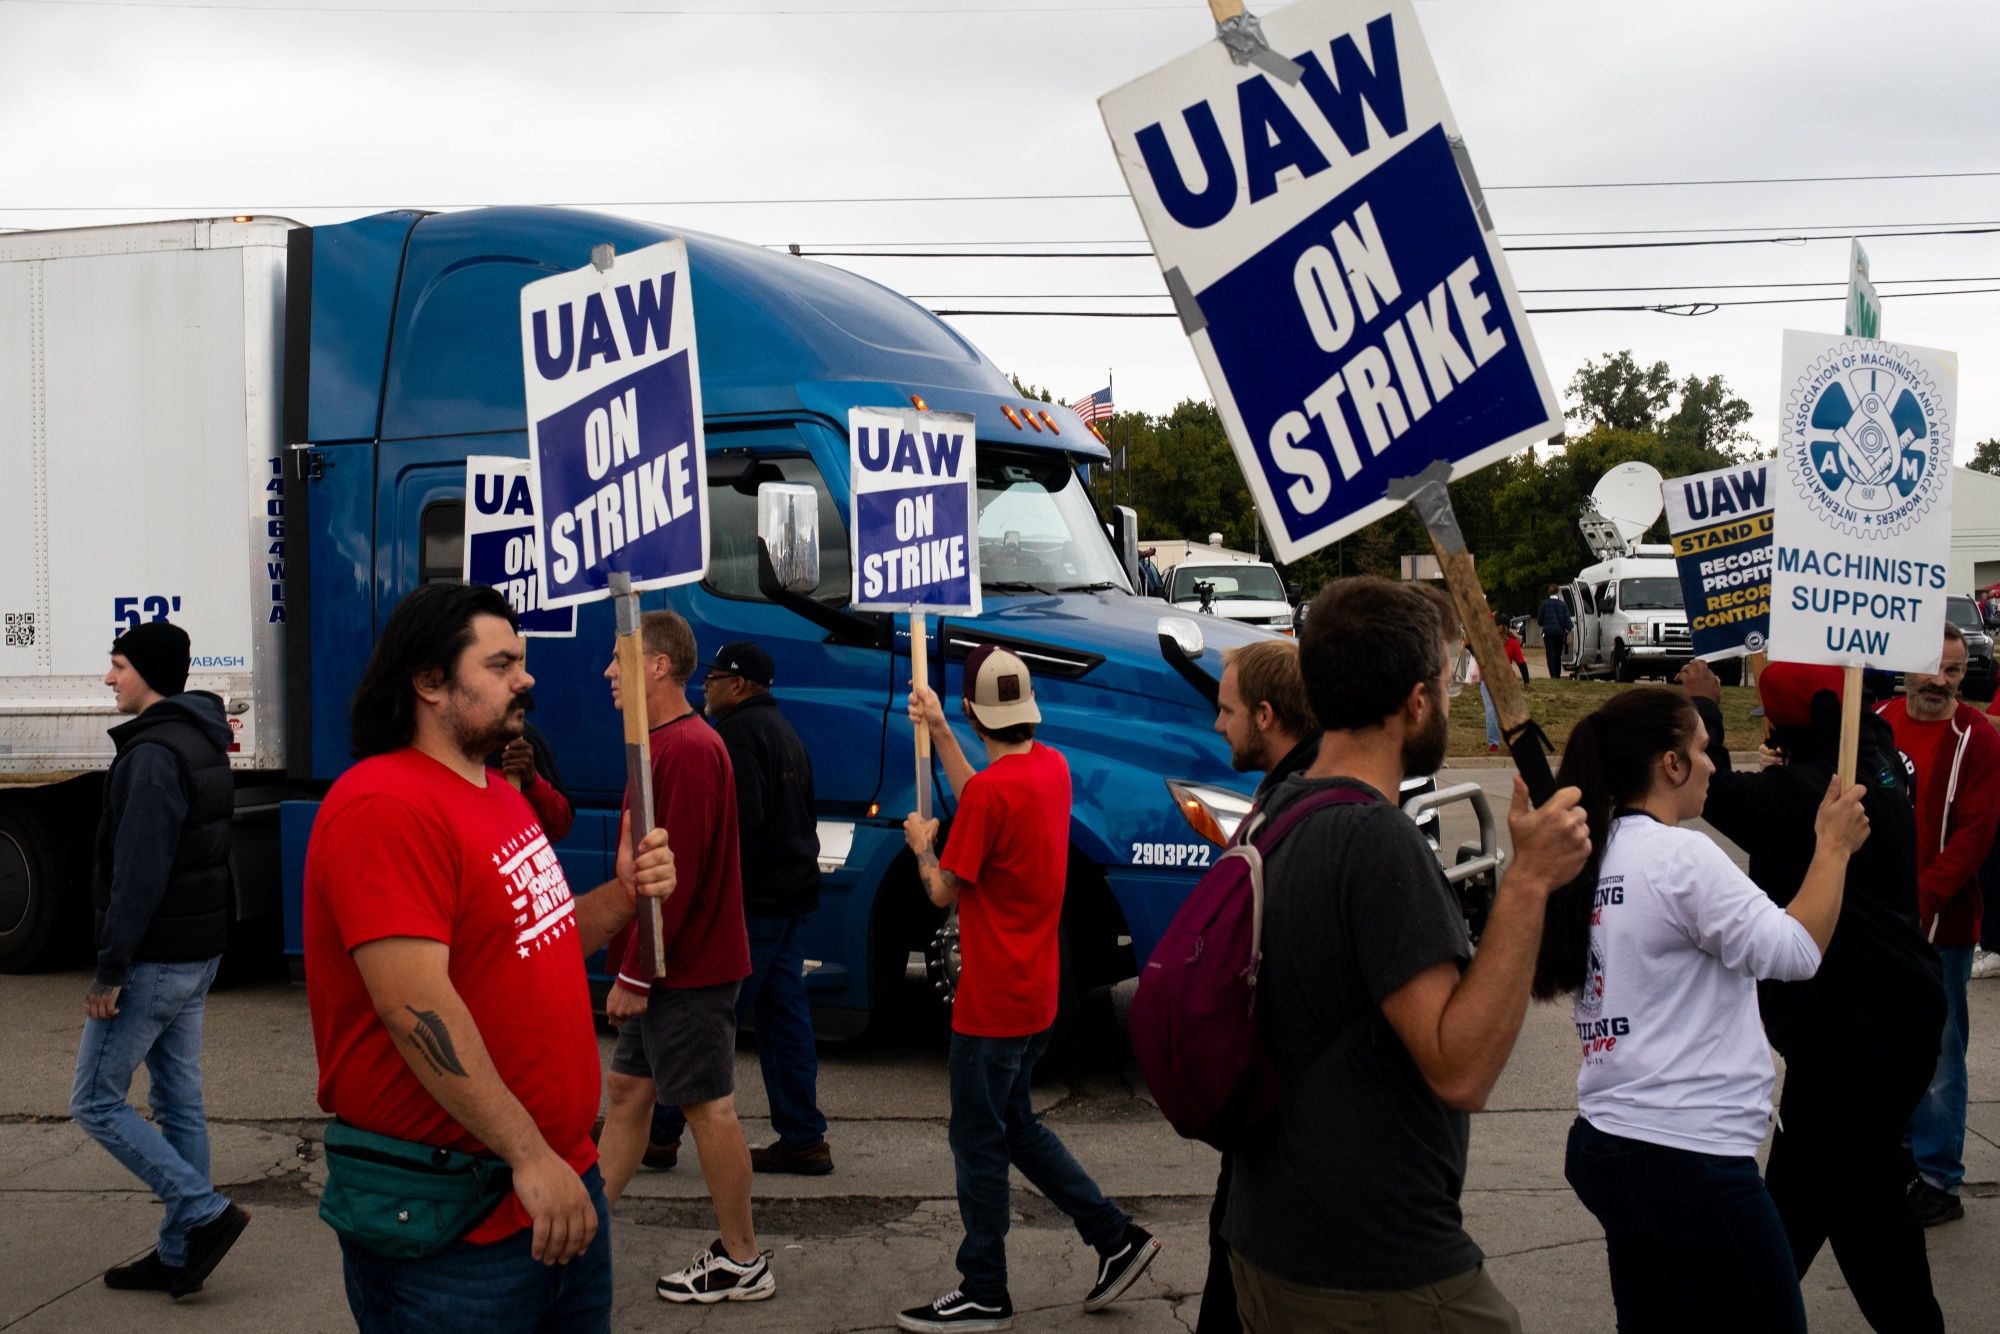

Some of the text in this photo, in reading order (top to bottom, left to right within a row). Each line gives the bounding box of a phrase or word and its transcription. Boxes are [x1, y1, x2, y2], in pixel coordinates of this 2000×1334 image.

[1134, 12, 1408, 230] UAW
[1293, 201, 1402, 353] ON
[532, 271, 676, 381] UAW
[1842, 355, 1857, 369] OF
[1860, 353, 1921, 391] MACHINISTS
[1268, 256, 1507, 515] STRIKE
[1796, 362, 1841, 437] ASSOCIATION
[1918, 391, 1934, 417] AND
[584, 387, 640, 481] ON
[857, 427, 964, 478] UAW
[1820, 451, 1918, 481] A M
[1918, 421, 1940, 494] AEROSPACE
[474, 474, 534, 515] UA
[1684, 467, 1767, 521] UAW
[1798, 441, 1857, 523] INTERNATIONAL
[551, 442, 693, 585] STRIKE
[895, 493, 933, 542] ON
[1876, 493, 1922, 526] WORKERS
[1681, 516, 1774, 553] STAND U
[863, 535, 965, 598] STRIKE
[1777, 547, 1946, 589] MACHINISTS
[492, 575, 536, 615] TRI
[1706, 583, 1772, 611] RECOR
[1791, 585, 1922, 622] SUPPORT
[1692, 601, 1771, 631] CONTRA
[190, 656, 244, 667] ABASH
[1826, 626, 1890, 656] UAW
[1132, 842, 1210, 867] 2903P22
